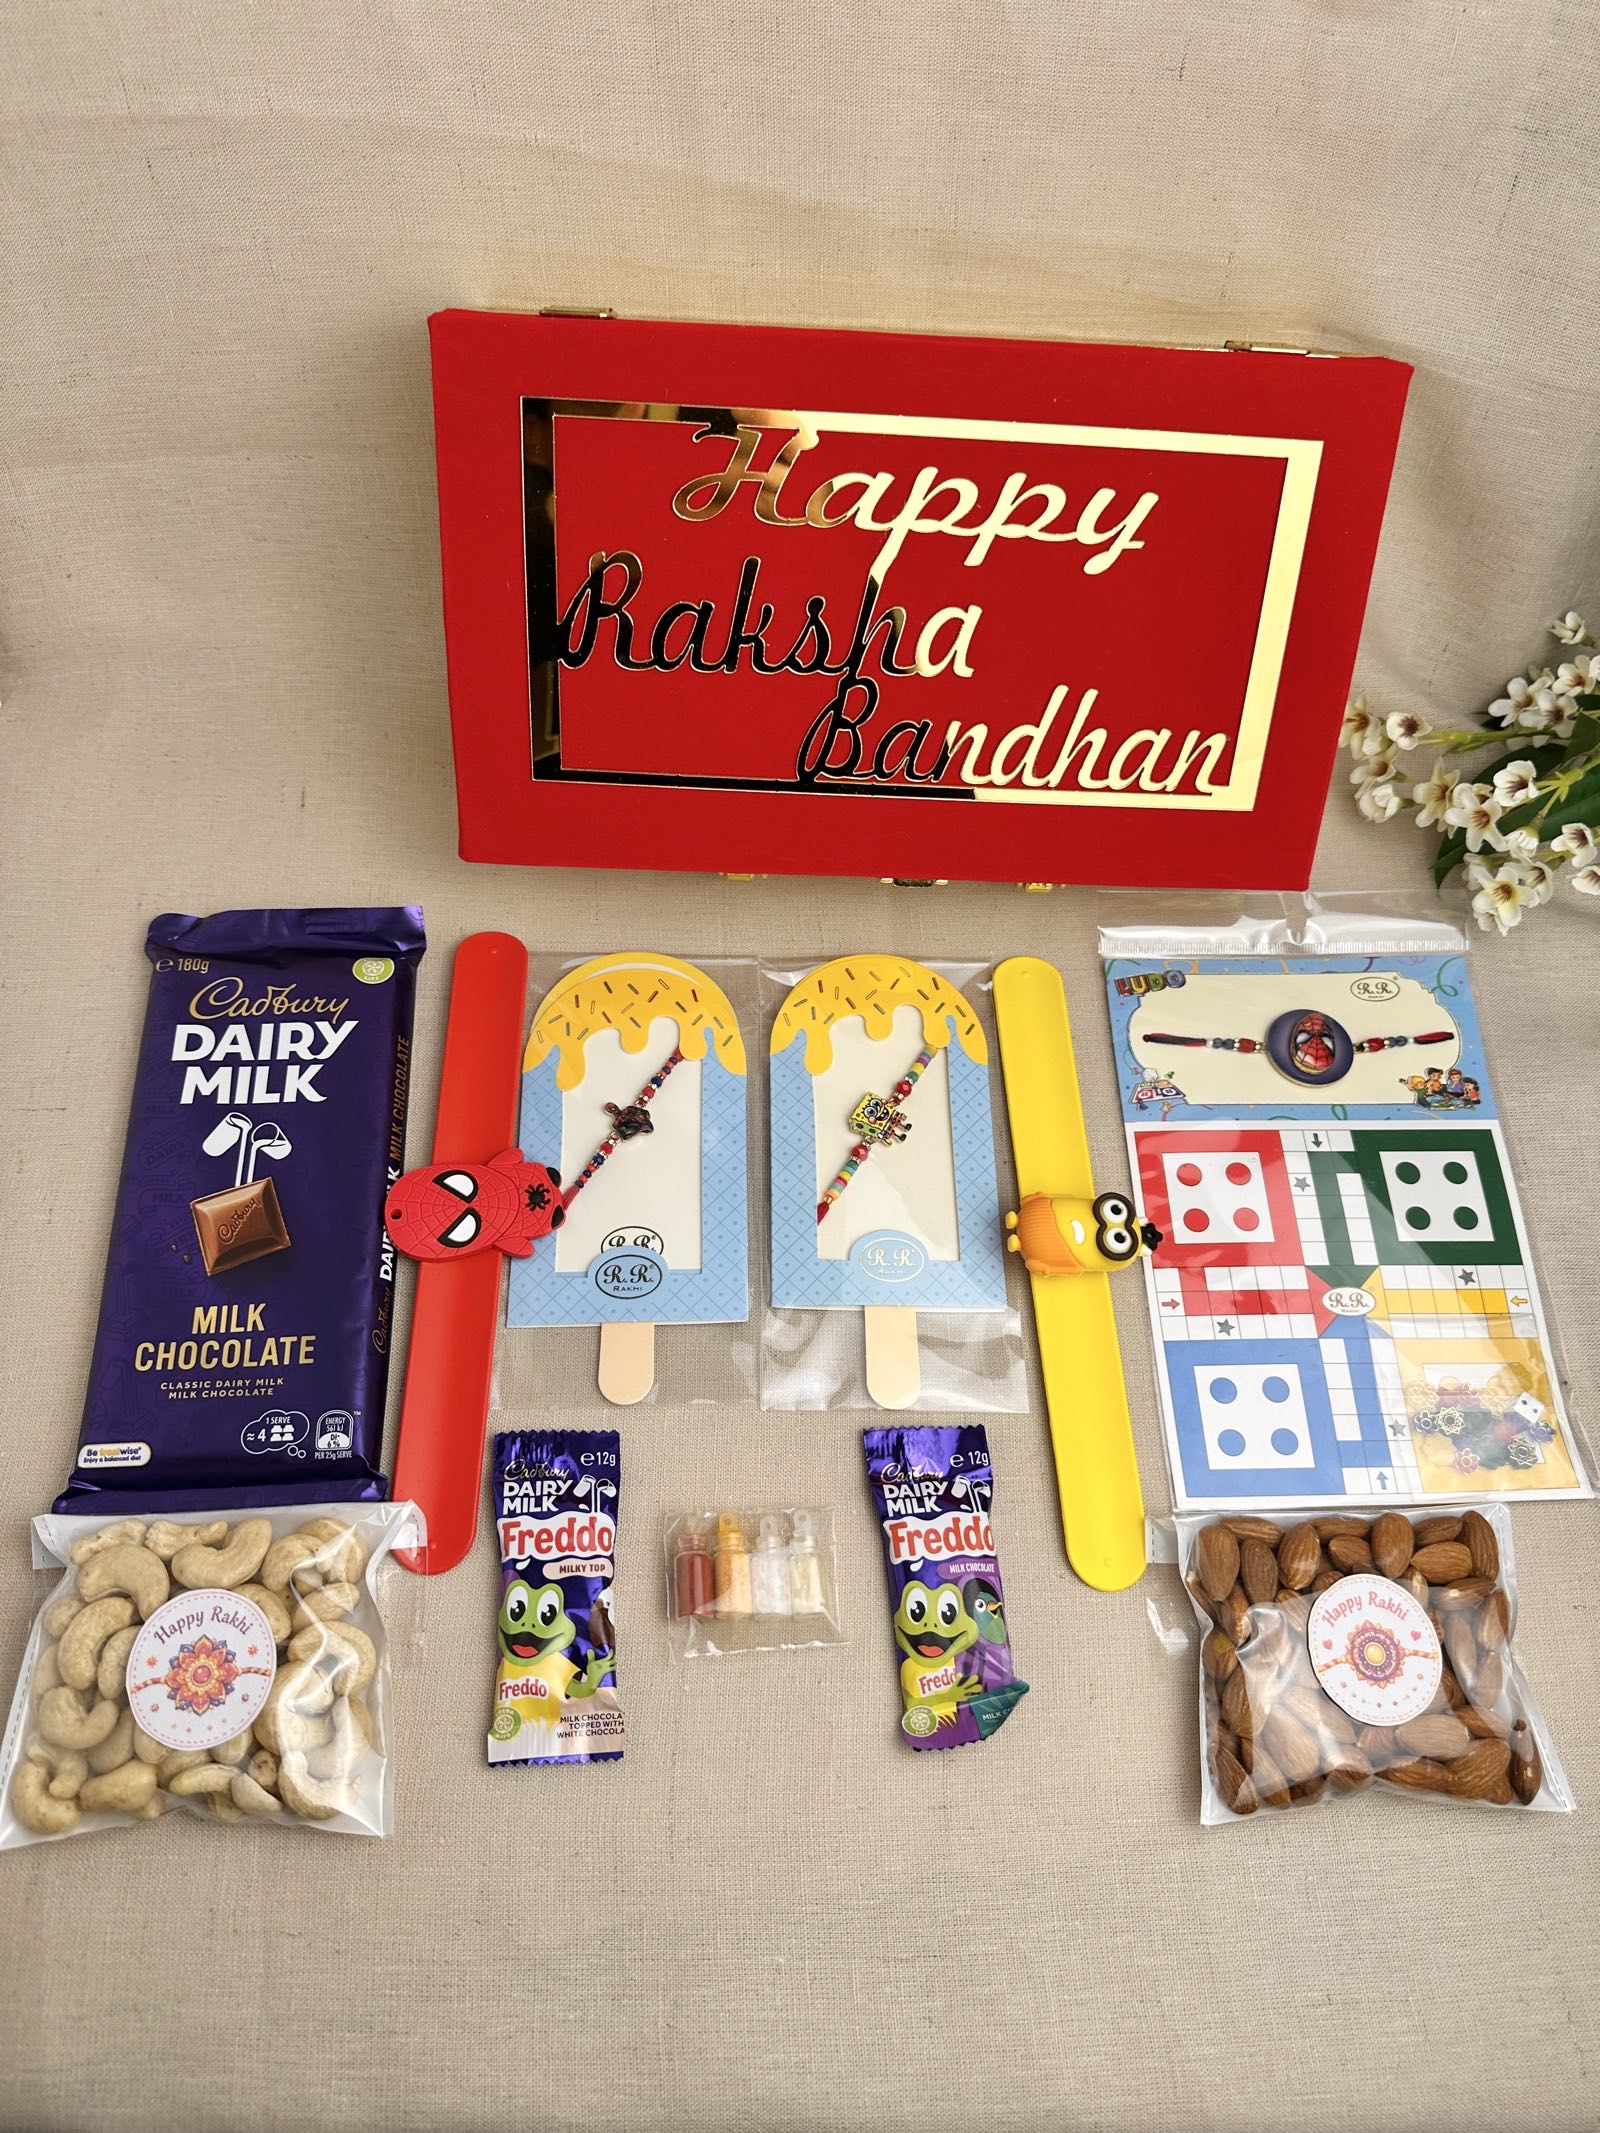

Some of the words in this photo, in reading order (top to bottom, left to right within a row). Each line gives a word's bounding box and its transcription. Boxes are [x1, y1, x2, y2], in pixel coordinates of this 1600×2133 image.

[672, 421, 1159, 575] Happy
[560, 551, 983, 678] Raksha
[799, 676, 1231, 795] Bandhan
[177, 958, 210, 974] 180g
[1114, 970, 1186, 997] LUDO
[189, 977, 349, 1024] Cadbury
[172, 1021, 359, 1061] DAIRY
[180, 1064, 327, 1104] MILK
[393, 1034, 409, 1120] CHOCOLATE
[390, 1122, 403, 1161] MILK
[218, 1198, 260, 1245] Cadbury
[192, 1303, 266, 1334] MILK
[135, 1335, 316, 1371] CHOCOLATE
[160, 1379, 213, 1390] CLASSIC
[216, 1378, 251, 1388] DAIRY
[256, 1377, 285, 1386] MILK
[168, 1390, 198, 1399] MILK
[202, 1387, 275, 1398] CHOCOLATE
[271, 1416, 291, 1424] SERVE
[325, 1417, 346, 1425] ENERGY
[257, 1428, 267, 1442] 4
[968, 1450, 989, 1466] 12g
[504, 1459, 570, 1480] Cadbury
[503, 1480, 573, 1497] DAIRY
[883, 1481, 948, 1499] DAIRY
[503, 1496, 559, 1515] MILK
[885, 1496, 942, 1517] MILK
[502, 1516, 613, 1558] Freddo
[559, 1564, 587, 1574] MILKY
[589, 1563, 606, 1572] TOP
[950, 1564, 965, 1574] MILK
[966, 1562, 995, 1573] CHOCOLATE
[1321, 1594, 1363, 1627] Happy
[1368, 1591, 1410, 1621] Rakhi
[154, 1610, 205, 1645] Happy
[210, 1605, 254, 1636] Rakhi
[500, 1678, 547, 1701] Freddo
[560, 1714, 580, 1723] MILK
[569, 1721, 602, 1730] TOPPED
[556, 1730, 584, 1739] WHITE
